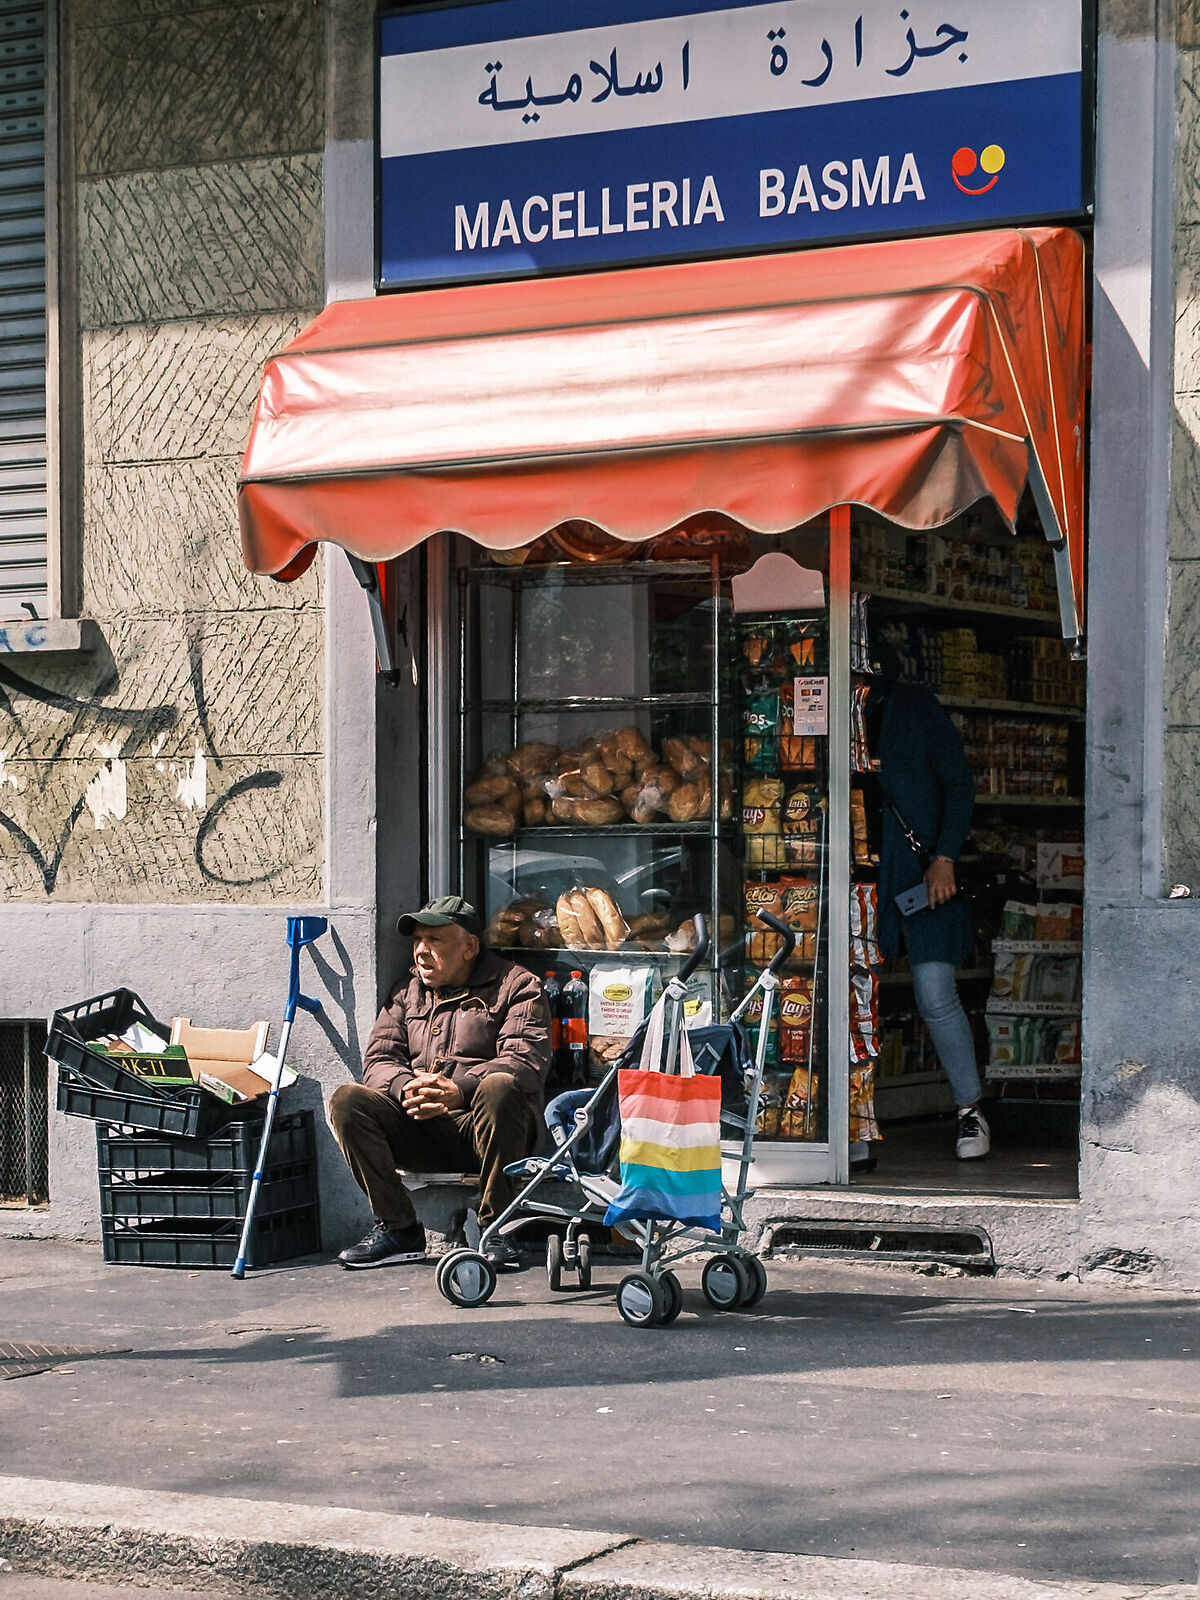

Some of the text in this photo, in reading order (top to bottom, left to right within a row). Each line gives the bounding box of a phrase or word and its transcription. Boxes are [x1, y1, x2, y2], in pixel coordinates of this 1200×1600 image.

[477, 10, 968, 124] جزارة اسلامية
[453, 152, 925, 251] MACELLERIA BASMA
